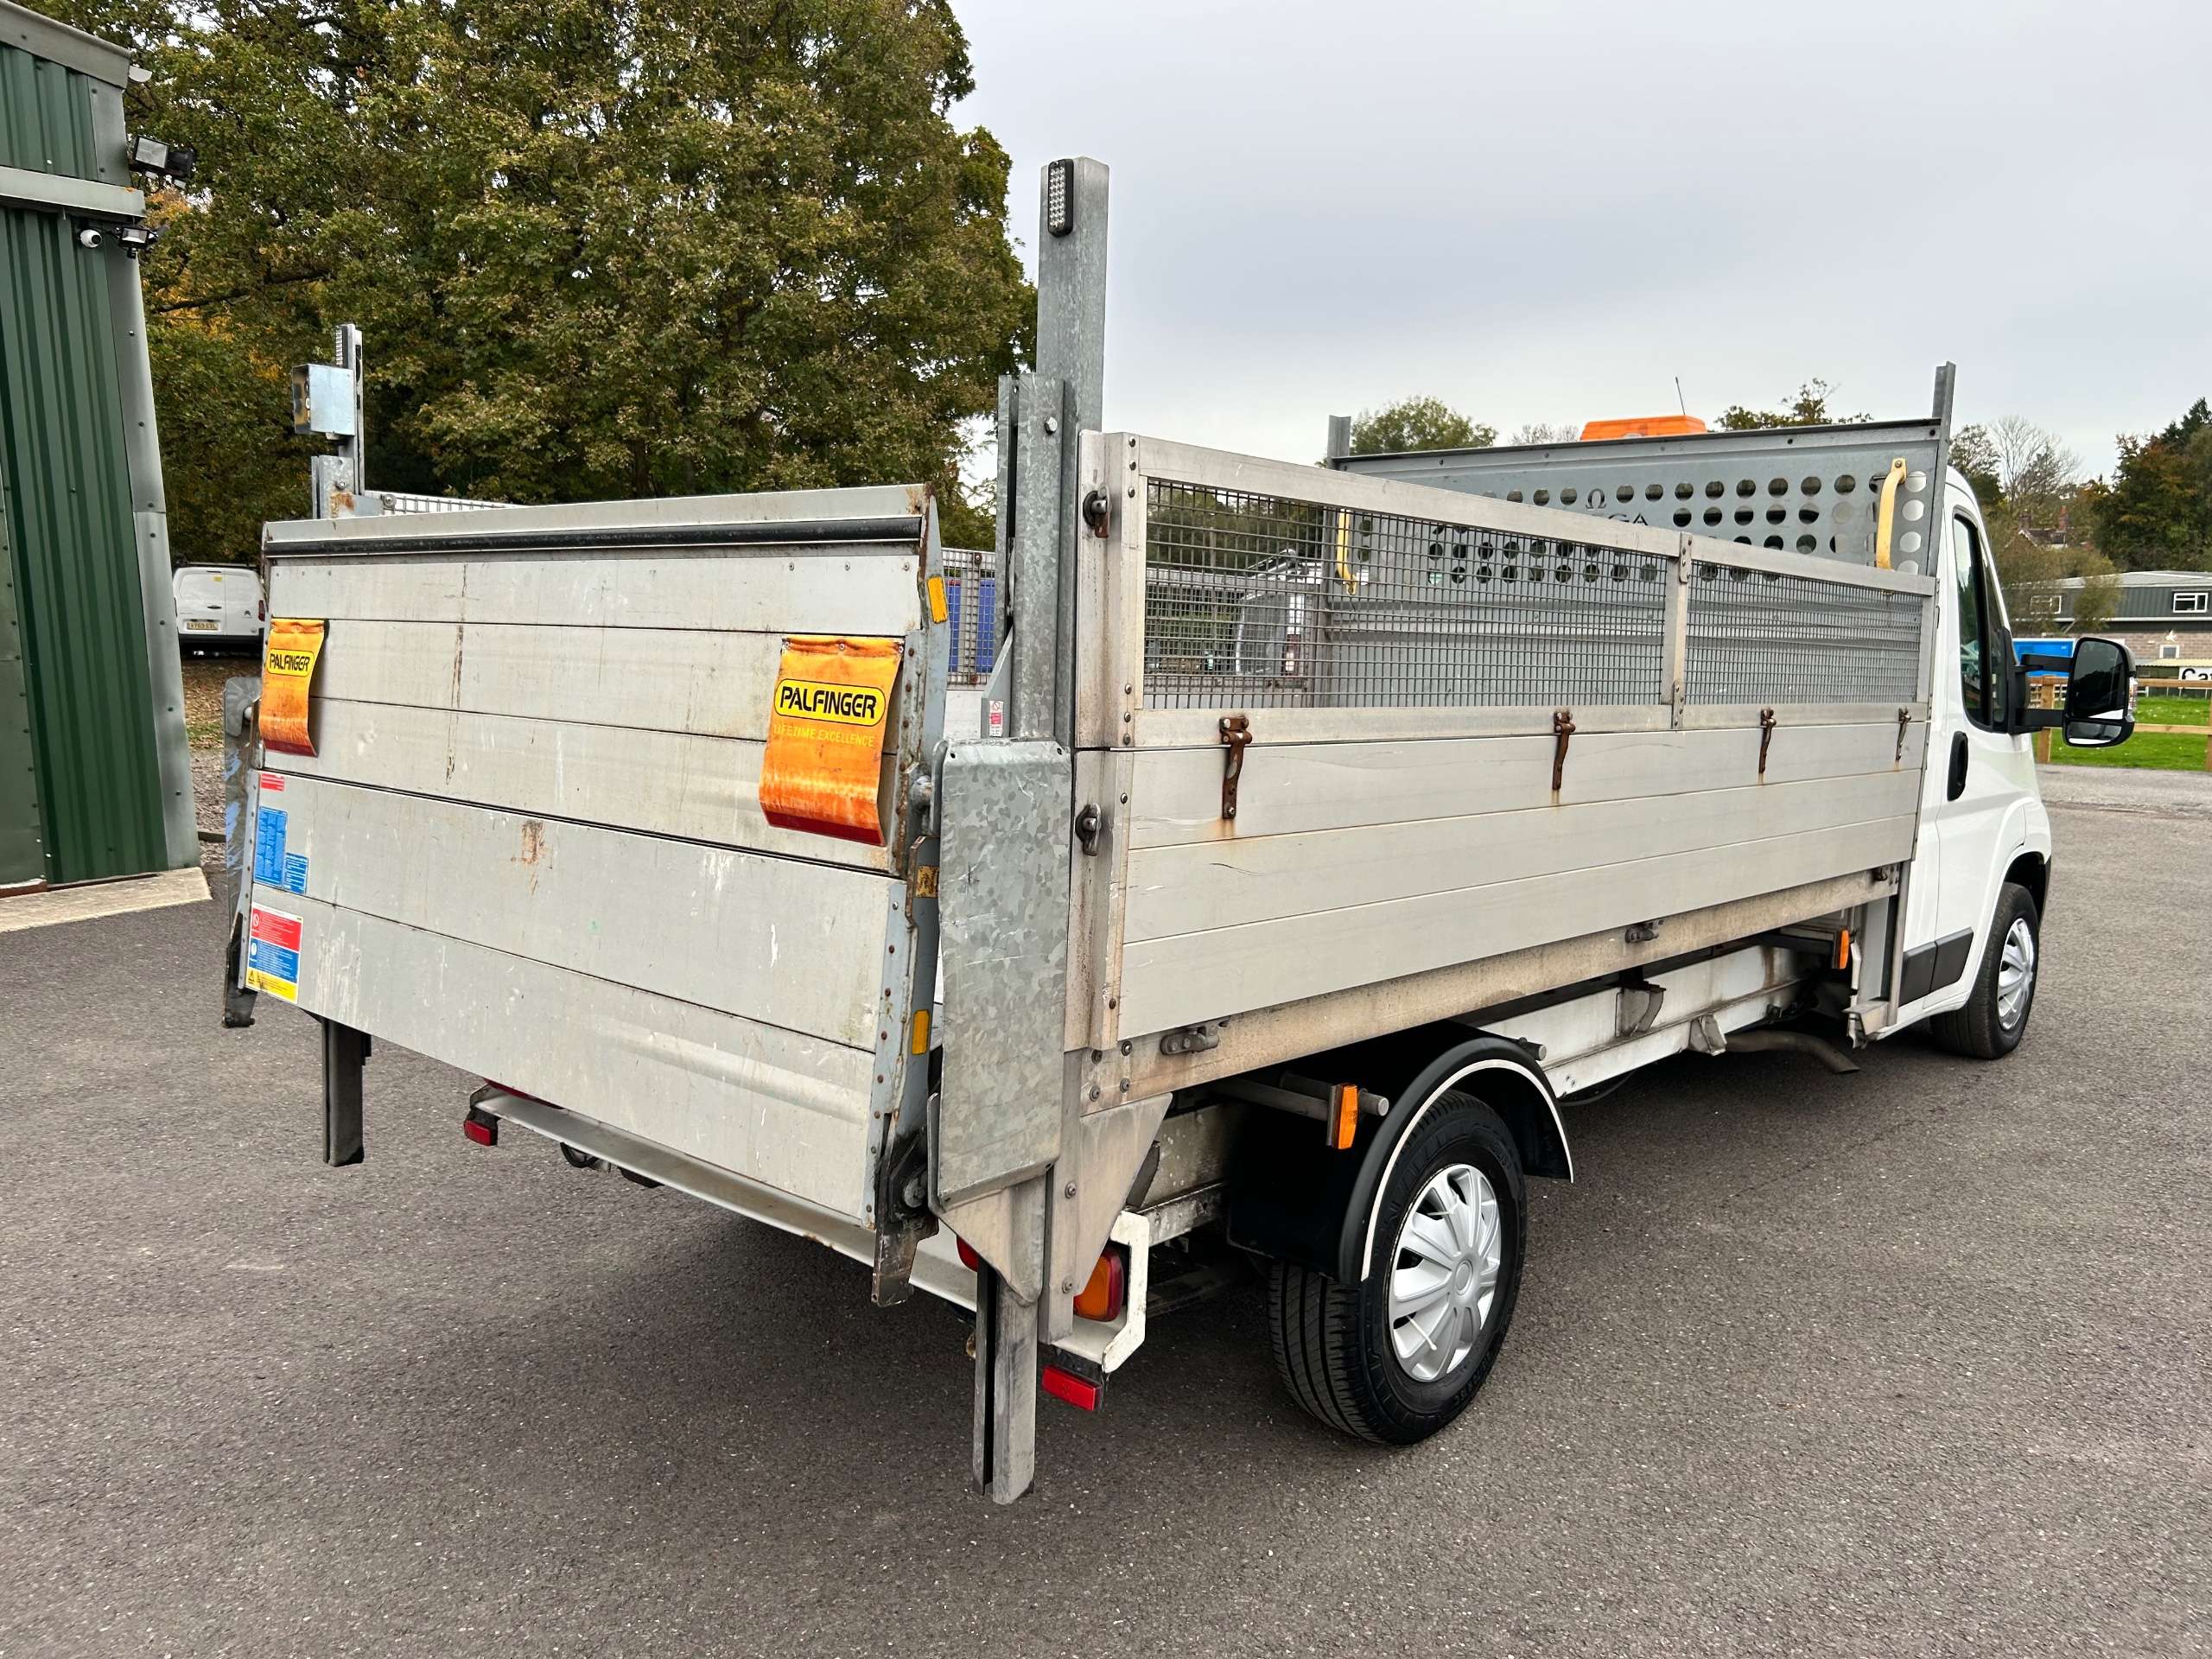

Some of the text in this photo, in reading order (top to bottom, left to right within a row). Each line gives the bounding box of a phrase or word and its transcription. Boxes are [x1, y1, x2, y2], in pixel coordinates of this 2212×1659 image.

[269, 653, 311, 672] PALFINGER
[779, 685, 878, 720] PALFINGER
[773, 723, 875, 747] LIFETIME EXCELLENCE
